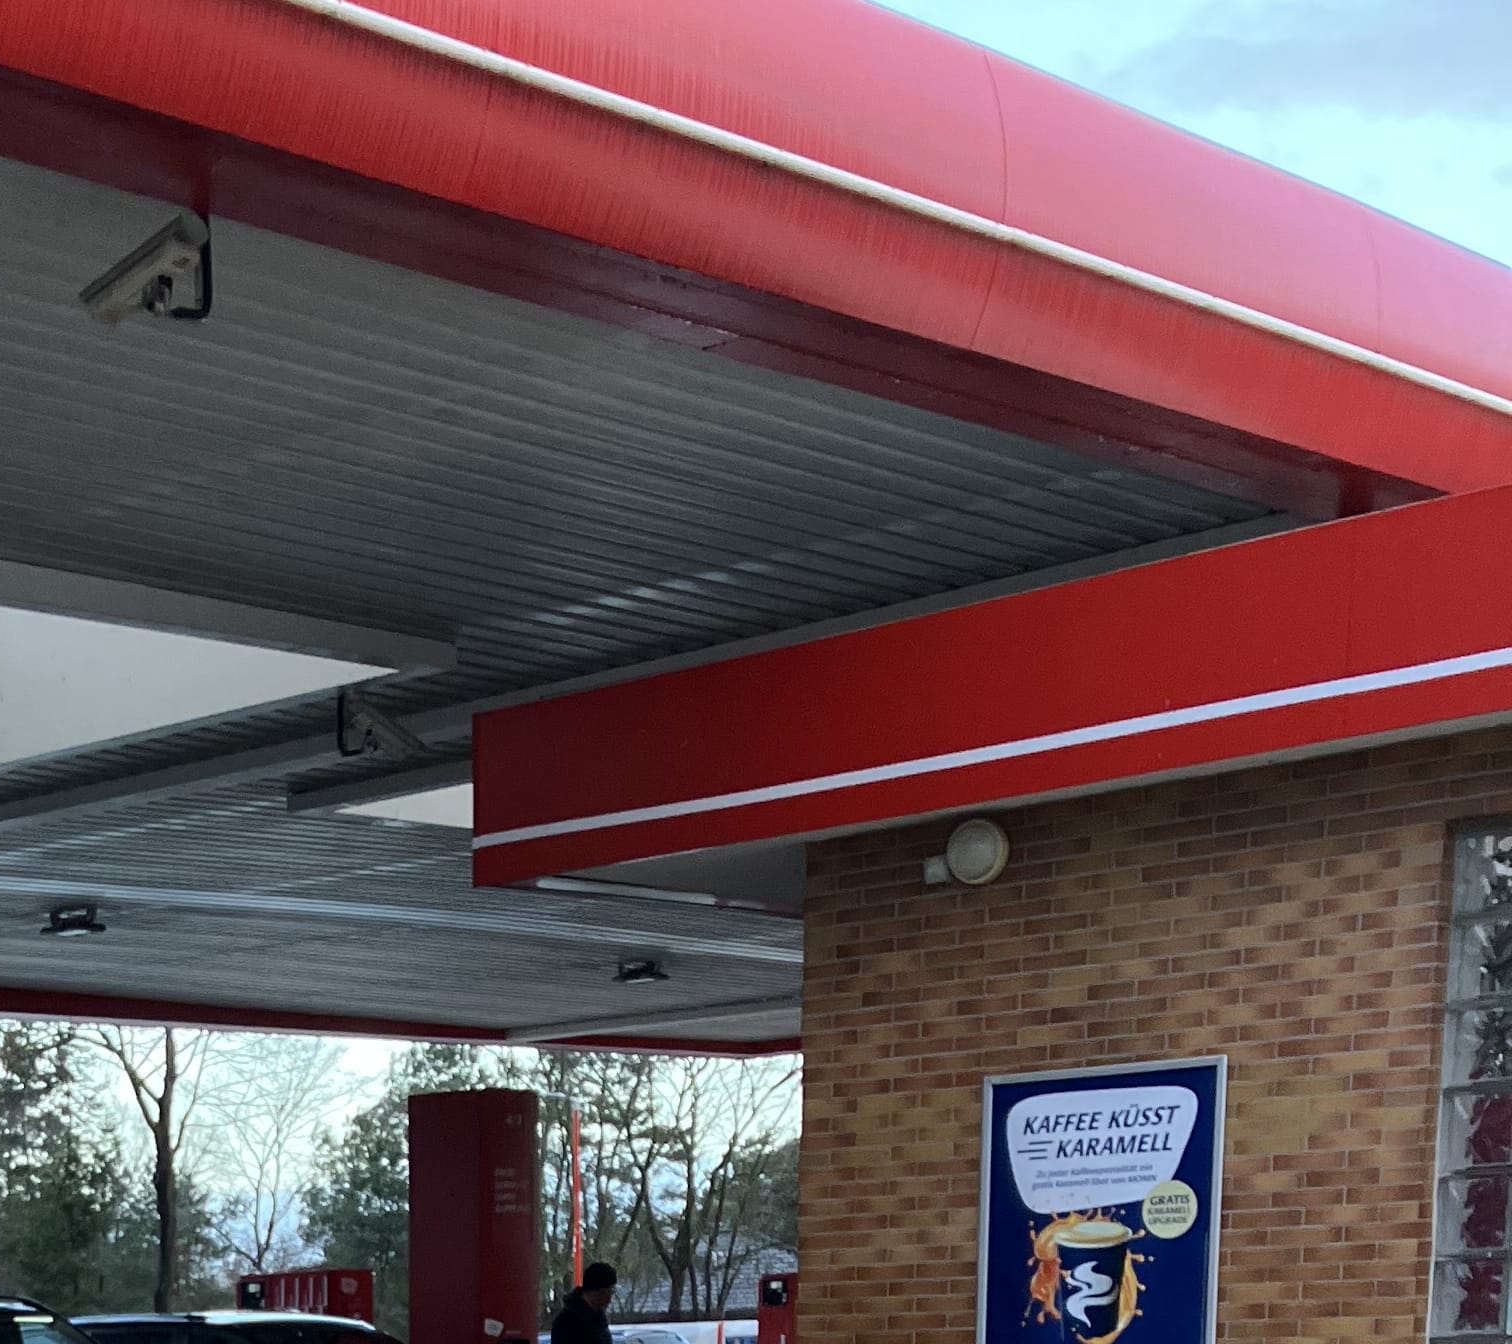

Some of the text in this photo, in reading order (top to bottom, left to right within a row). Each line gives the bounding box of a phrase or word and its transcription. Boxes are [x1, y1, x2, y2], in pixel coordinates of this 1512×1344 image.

[1023, 1103, 1181, 1136] KAFFEE KÜSST
[1056, 1132, 1173, 1159] KARAMELL
[1150, 1194, 1190, 1206] GRATIS
